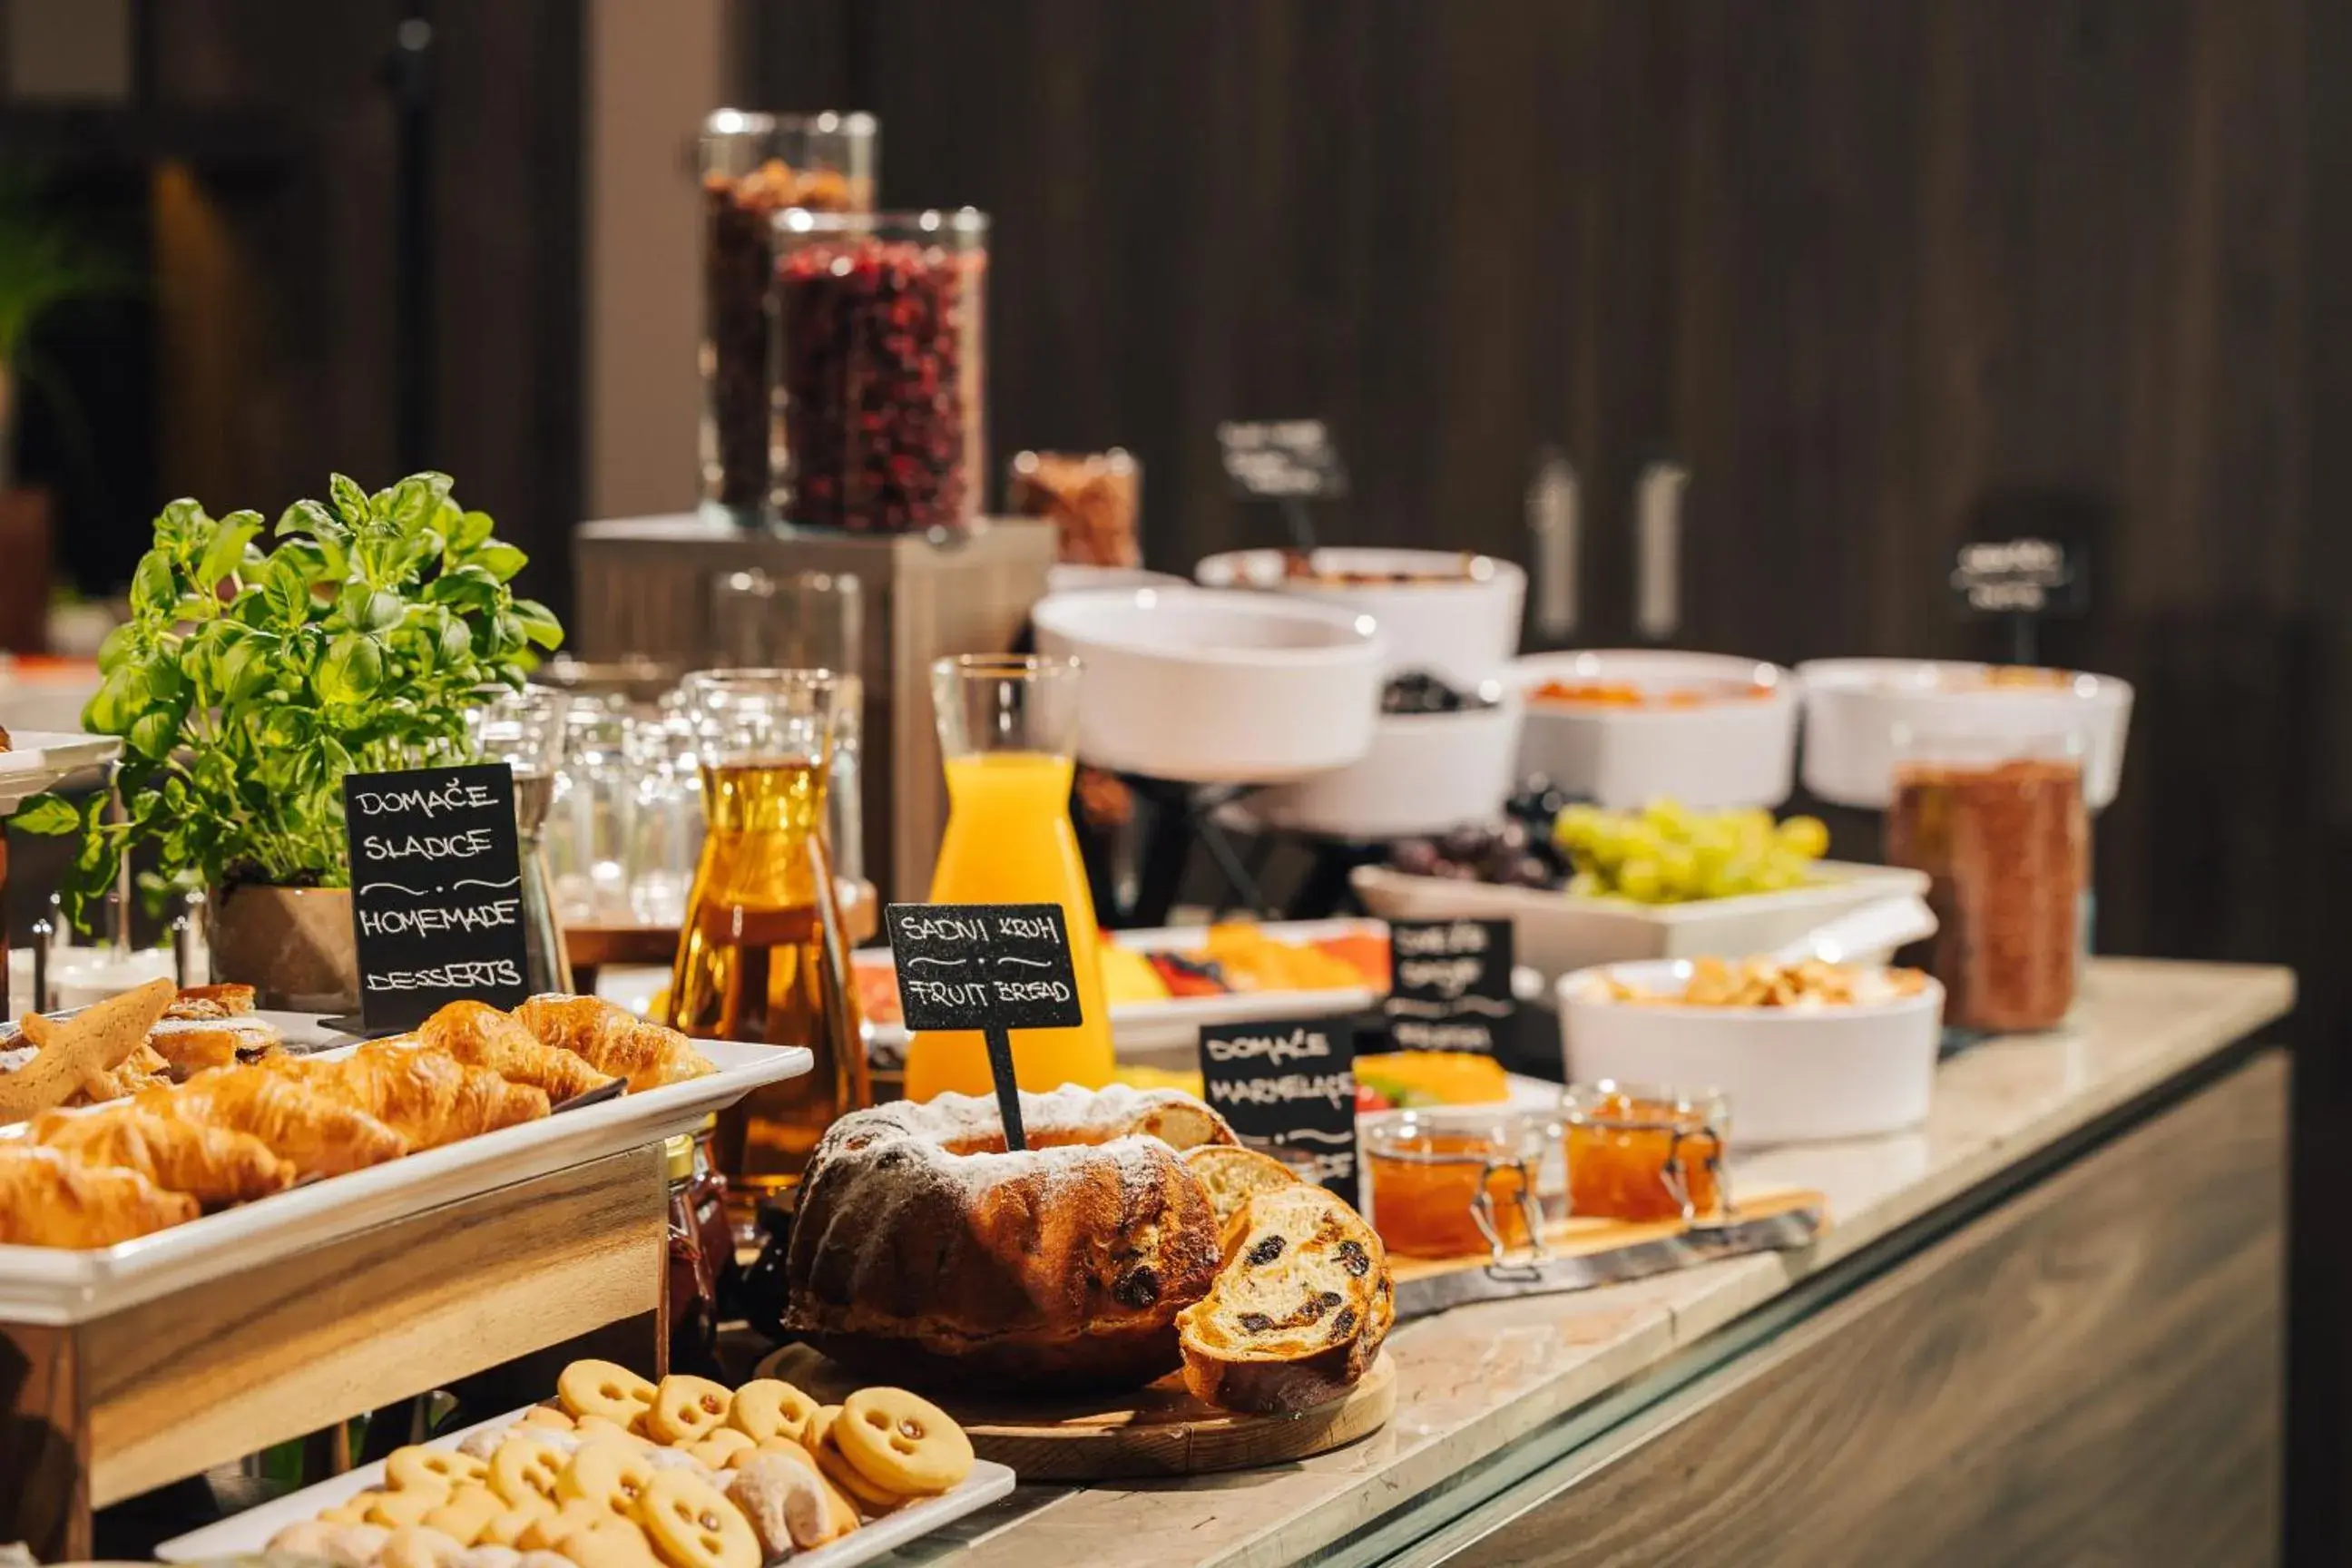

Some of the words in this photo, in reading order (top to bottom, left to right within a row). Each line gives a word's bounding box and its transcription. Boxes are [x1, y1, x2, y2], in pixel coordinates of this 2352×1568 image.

[355, 777, 499, 818] DOMAČE
[363, 828, 493, 861] SLADICE
[358, 897, 520, 938] HOMEMADE
[900, 916, 990, 943] SADNI
[998, 916, 1061, 944] KRUH
[367, 959, 523, 991] DESSERTS
[908, 980, 989, 1007] FRUIT
[993, 980, 1071, 1003] BREAD
